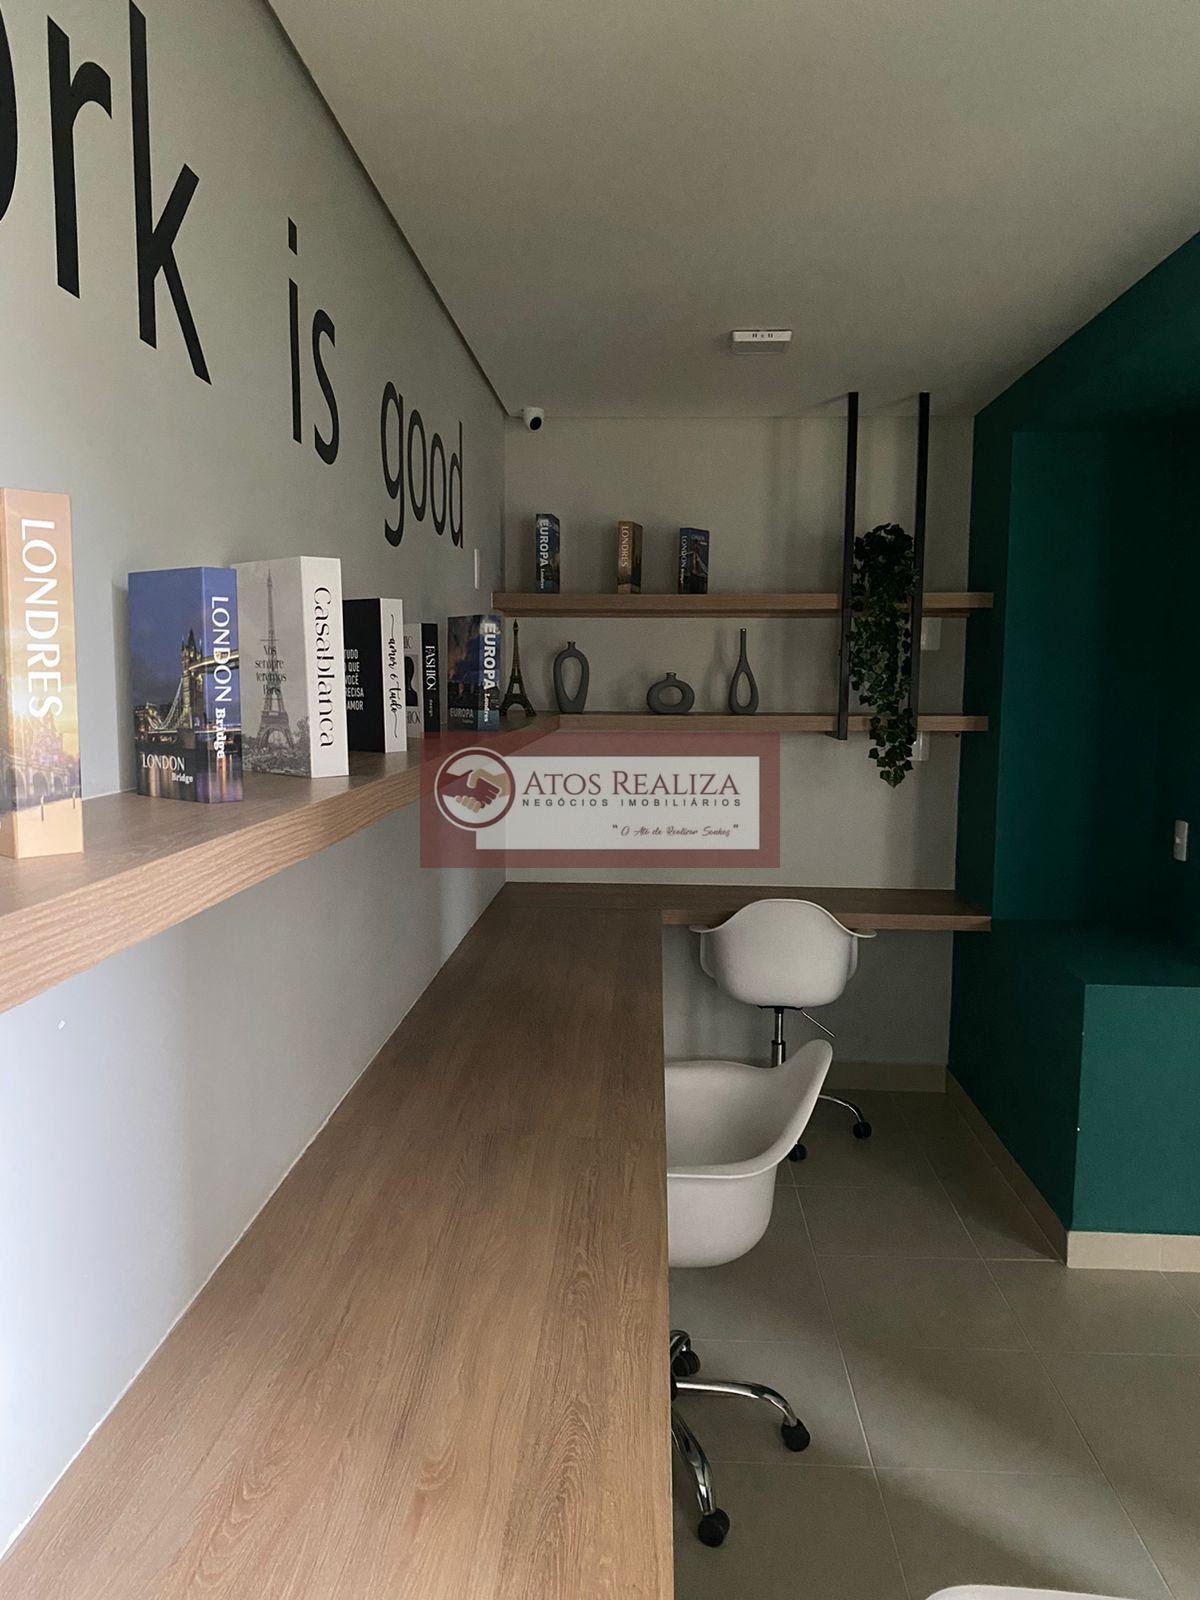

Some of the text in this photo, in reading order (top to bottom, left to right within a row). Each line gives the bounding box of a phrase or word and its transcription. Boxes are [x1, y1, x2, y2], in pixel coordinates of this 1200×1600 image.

[288, 216, 340, 466] is
[380, 380, 464, 549] good
[539, 518, 550, 568] EUROPA
[621, 525, 630, 568] LONDRES
[680, 535, 688, 568] LONDON
[20, 518, 63, 719] LONDRES
[313, 586, 336, 748] Casablanca
[348, 661, 361, 674] QUE
[388, 637, 397, 669] amor
[484, 622, 497, 690] EUROPA
[211, 596, 233, 760] LONDON Bridge
[346, 700, 364, 711] AMOR
[449, 707, 474, 719] EUROPA
[141, 753, 186, 772] LONDON
[171, 772, 194, 784] Bridge
